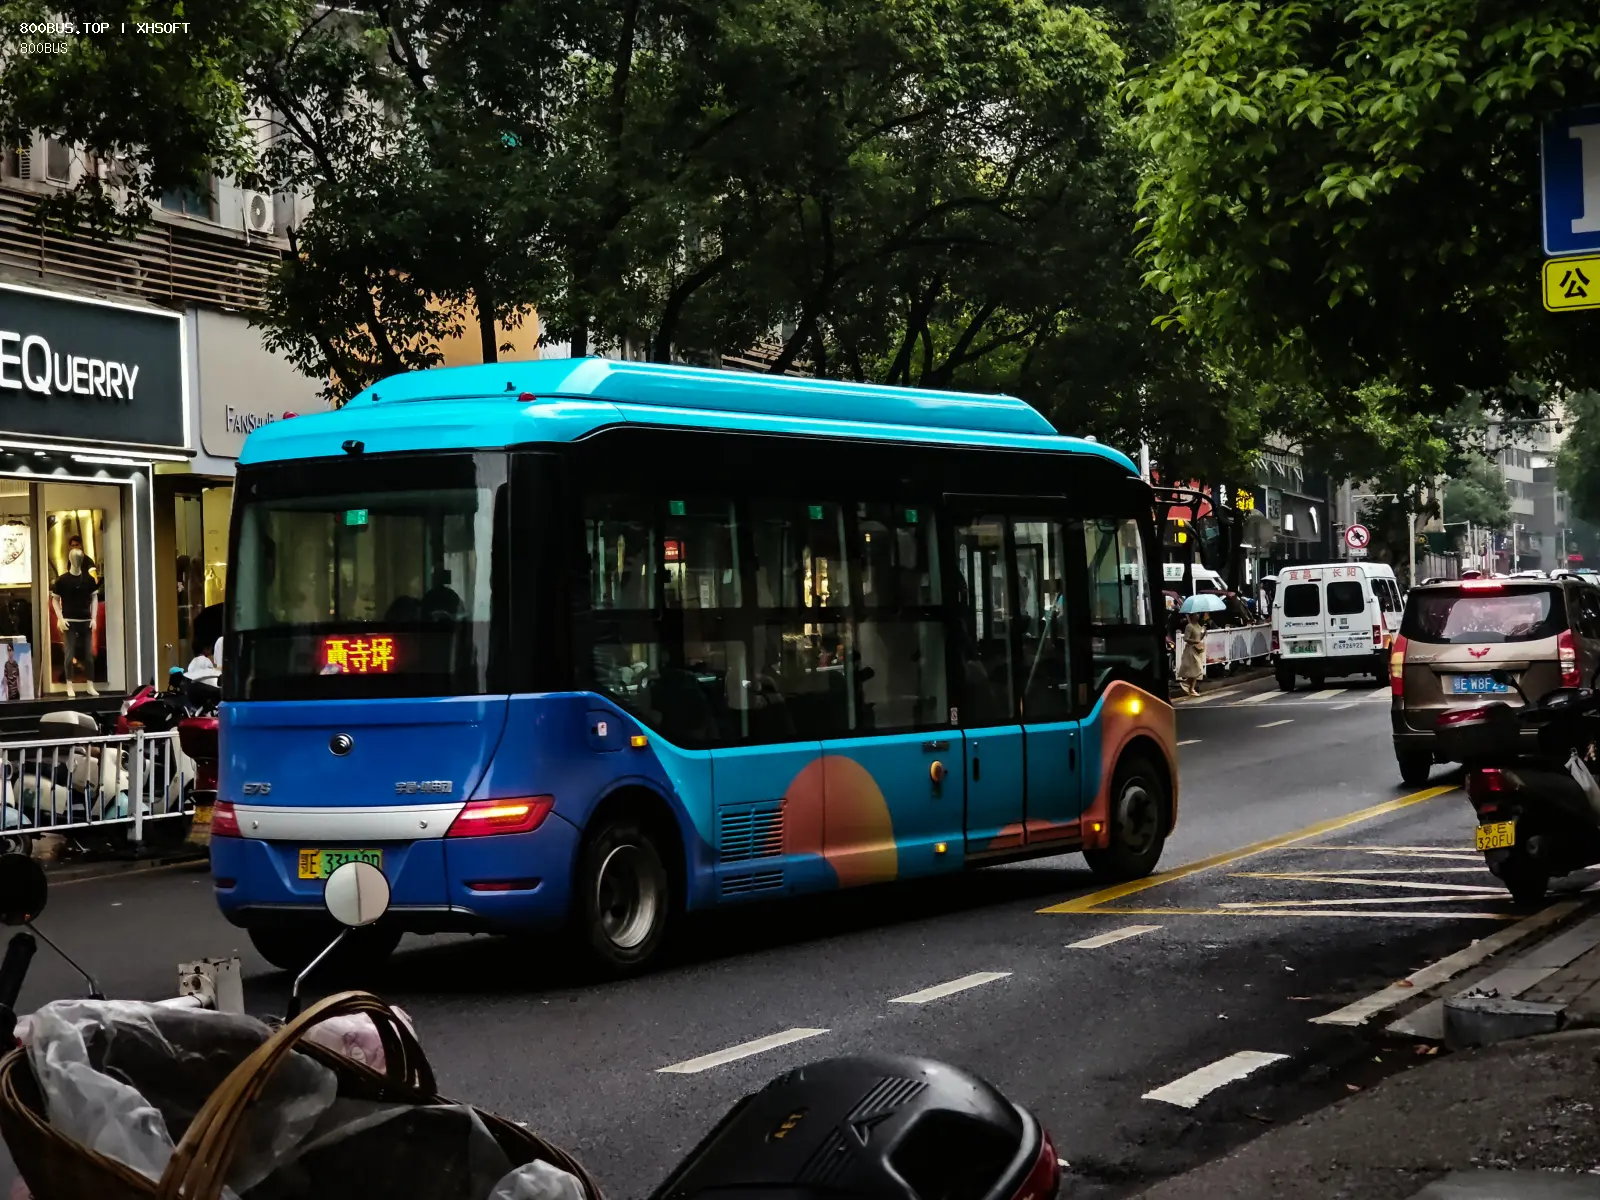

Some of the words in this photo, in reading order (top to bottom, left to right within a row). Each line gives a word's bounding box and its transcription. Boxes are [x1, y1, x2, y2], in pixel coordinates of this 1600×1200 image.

[1559, 267, 1591, 299] 公
[1290, 569, 1312, 580] 宜昌
[1333, 567, 1356, 577] 长阳
[1478, 833, 1513, 850] 320FU
